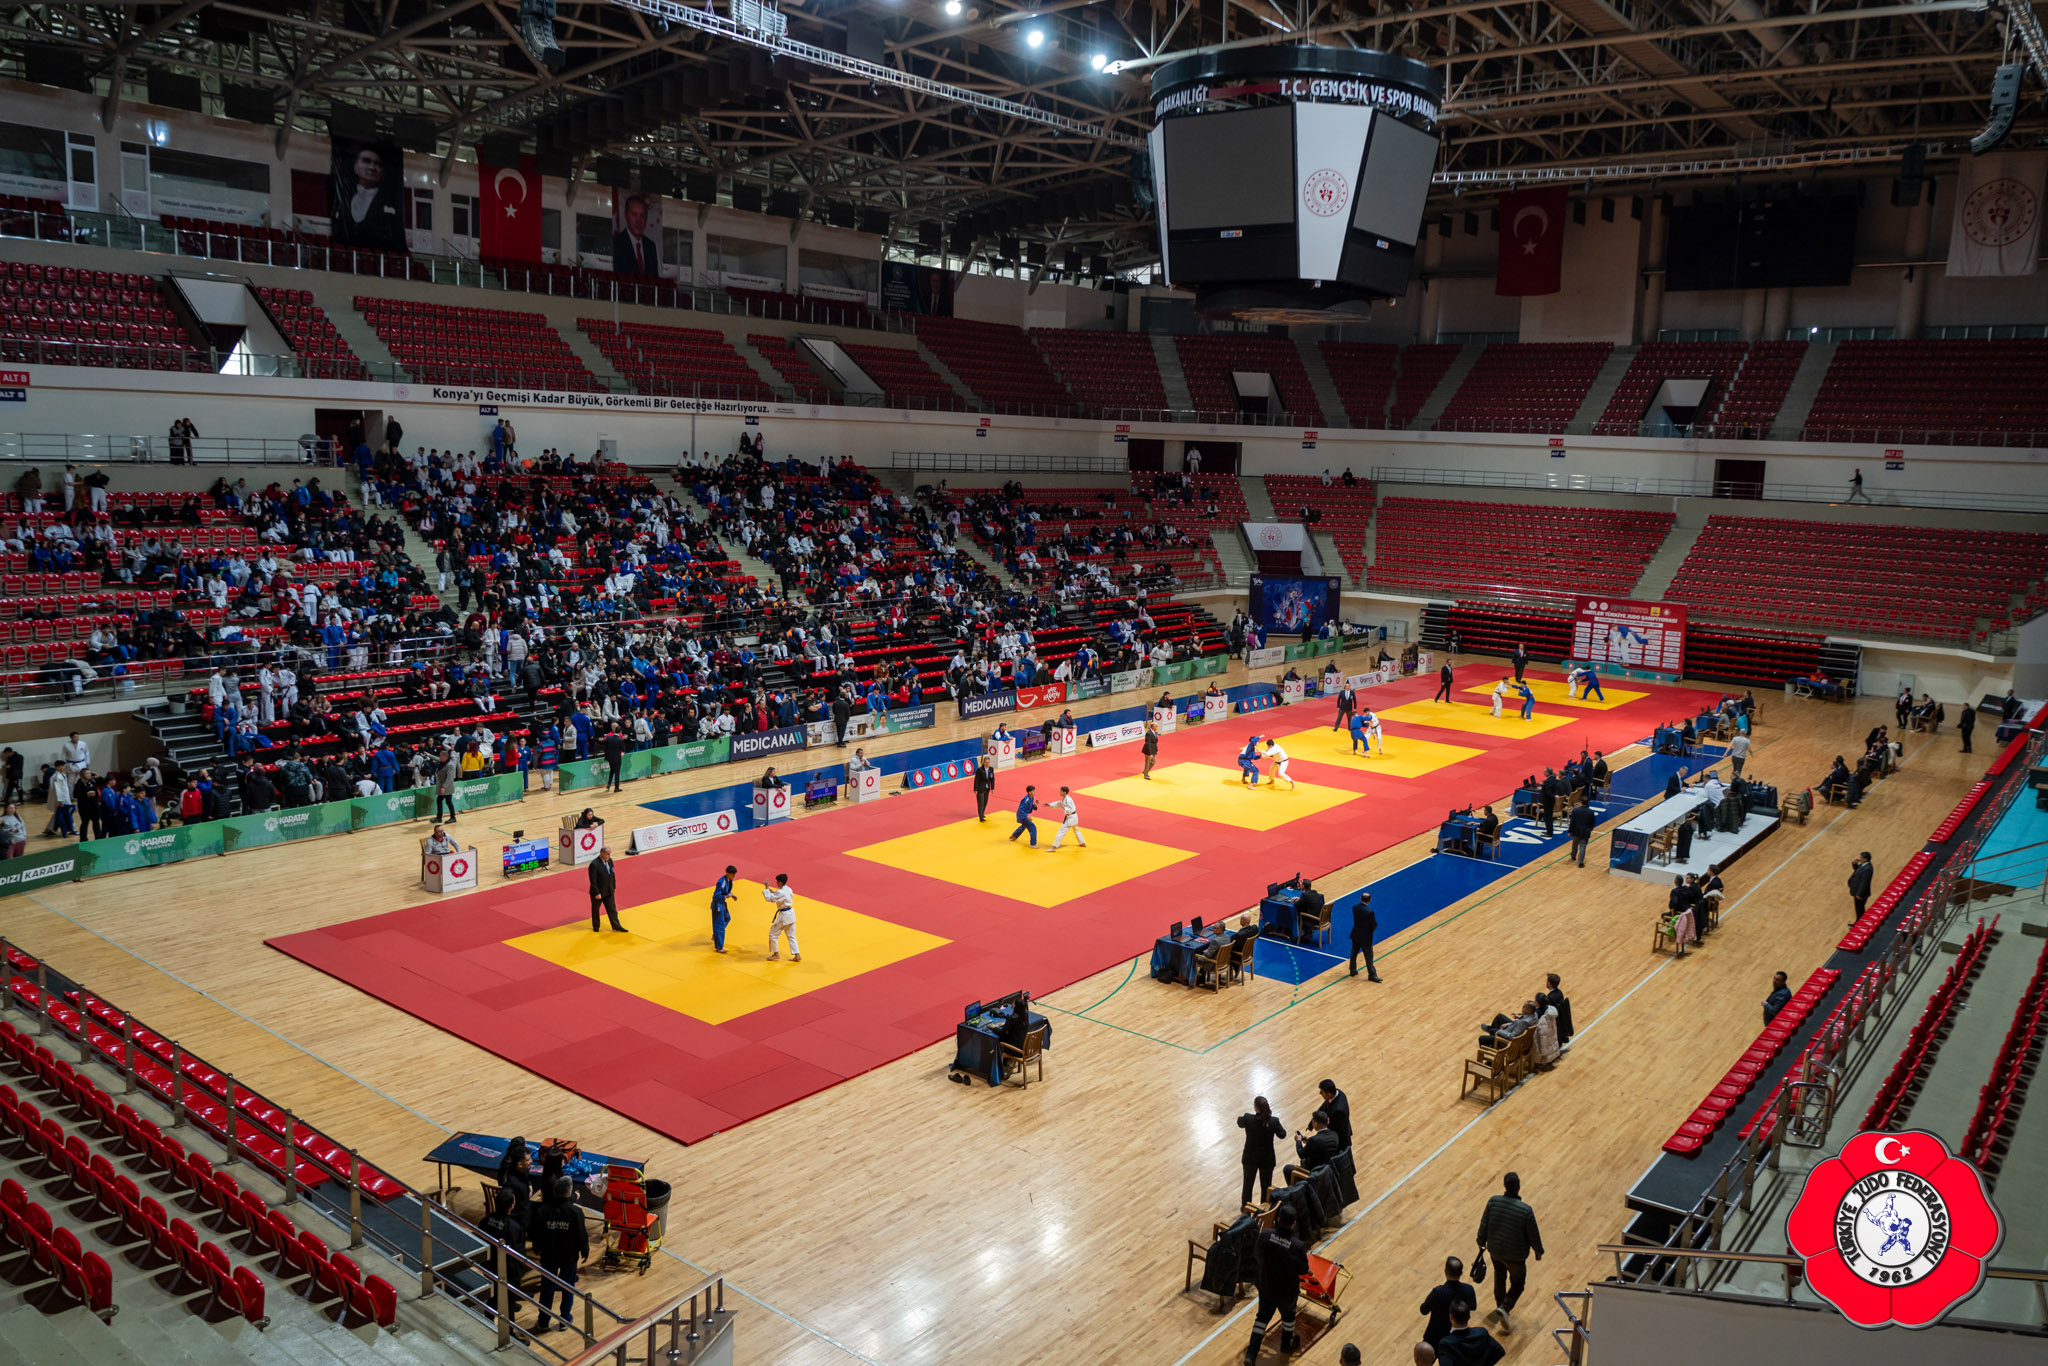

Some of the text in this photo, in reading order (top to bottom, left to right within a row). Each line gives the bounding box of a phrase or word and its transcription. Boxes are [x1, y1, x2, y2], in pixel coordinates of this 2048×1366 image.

[1280, 79, 1306, 96] T.C.
[1310, 80, 1368, 105] GENÇLİK
[1370, 84, 1386, 103] VE
[1386, 88, 1412, 111] SPOR
[2, 374, 18, 382] ALT
[486, 390, 530, 403] Geçmişi
[534, 392, 565, 404] Kadar
[568, 394, 603, 407] Büyük,
[606, 396, 651, 408] Görkemli
[654, 399, 666, 408] Bir
[670, 400, 712, 412] Geleceğe
[715, 402, 770, 414] Hazırlıyoruz.
[965, 696, 1009, 714] MEDICANA
[734, 734, 796, 754] MEDICANA
[279, 812, 310, 825] KARATAY
[668, 822, 707, 838] SPORTOTO
[142, 834, 176, 847] KARATAY
[24, 862, 71, 880] KARATAY
[520, 860, 539, 870] 3:55
